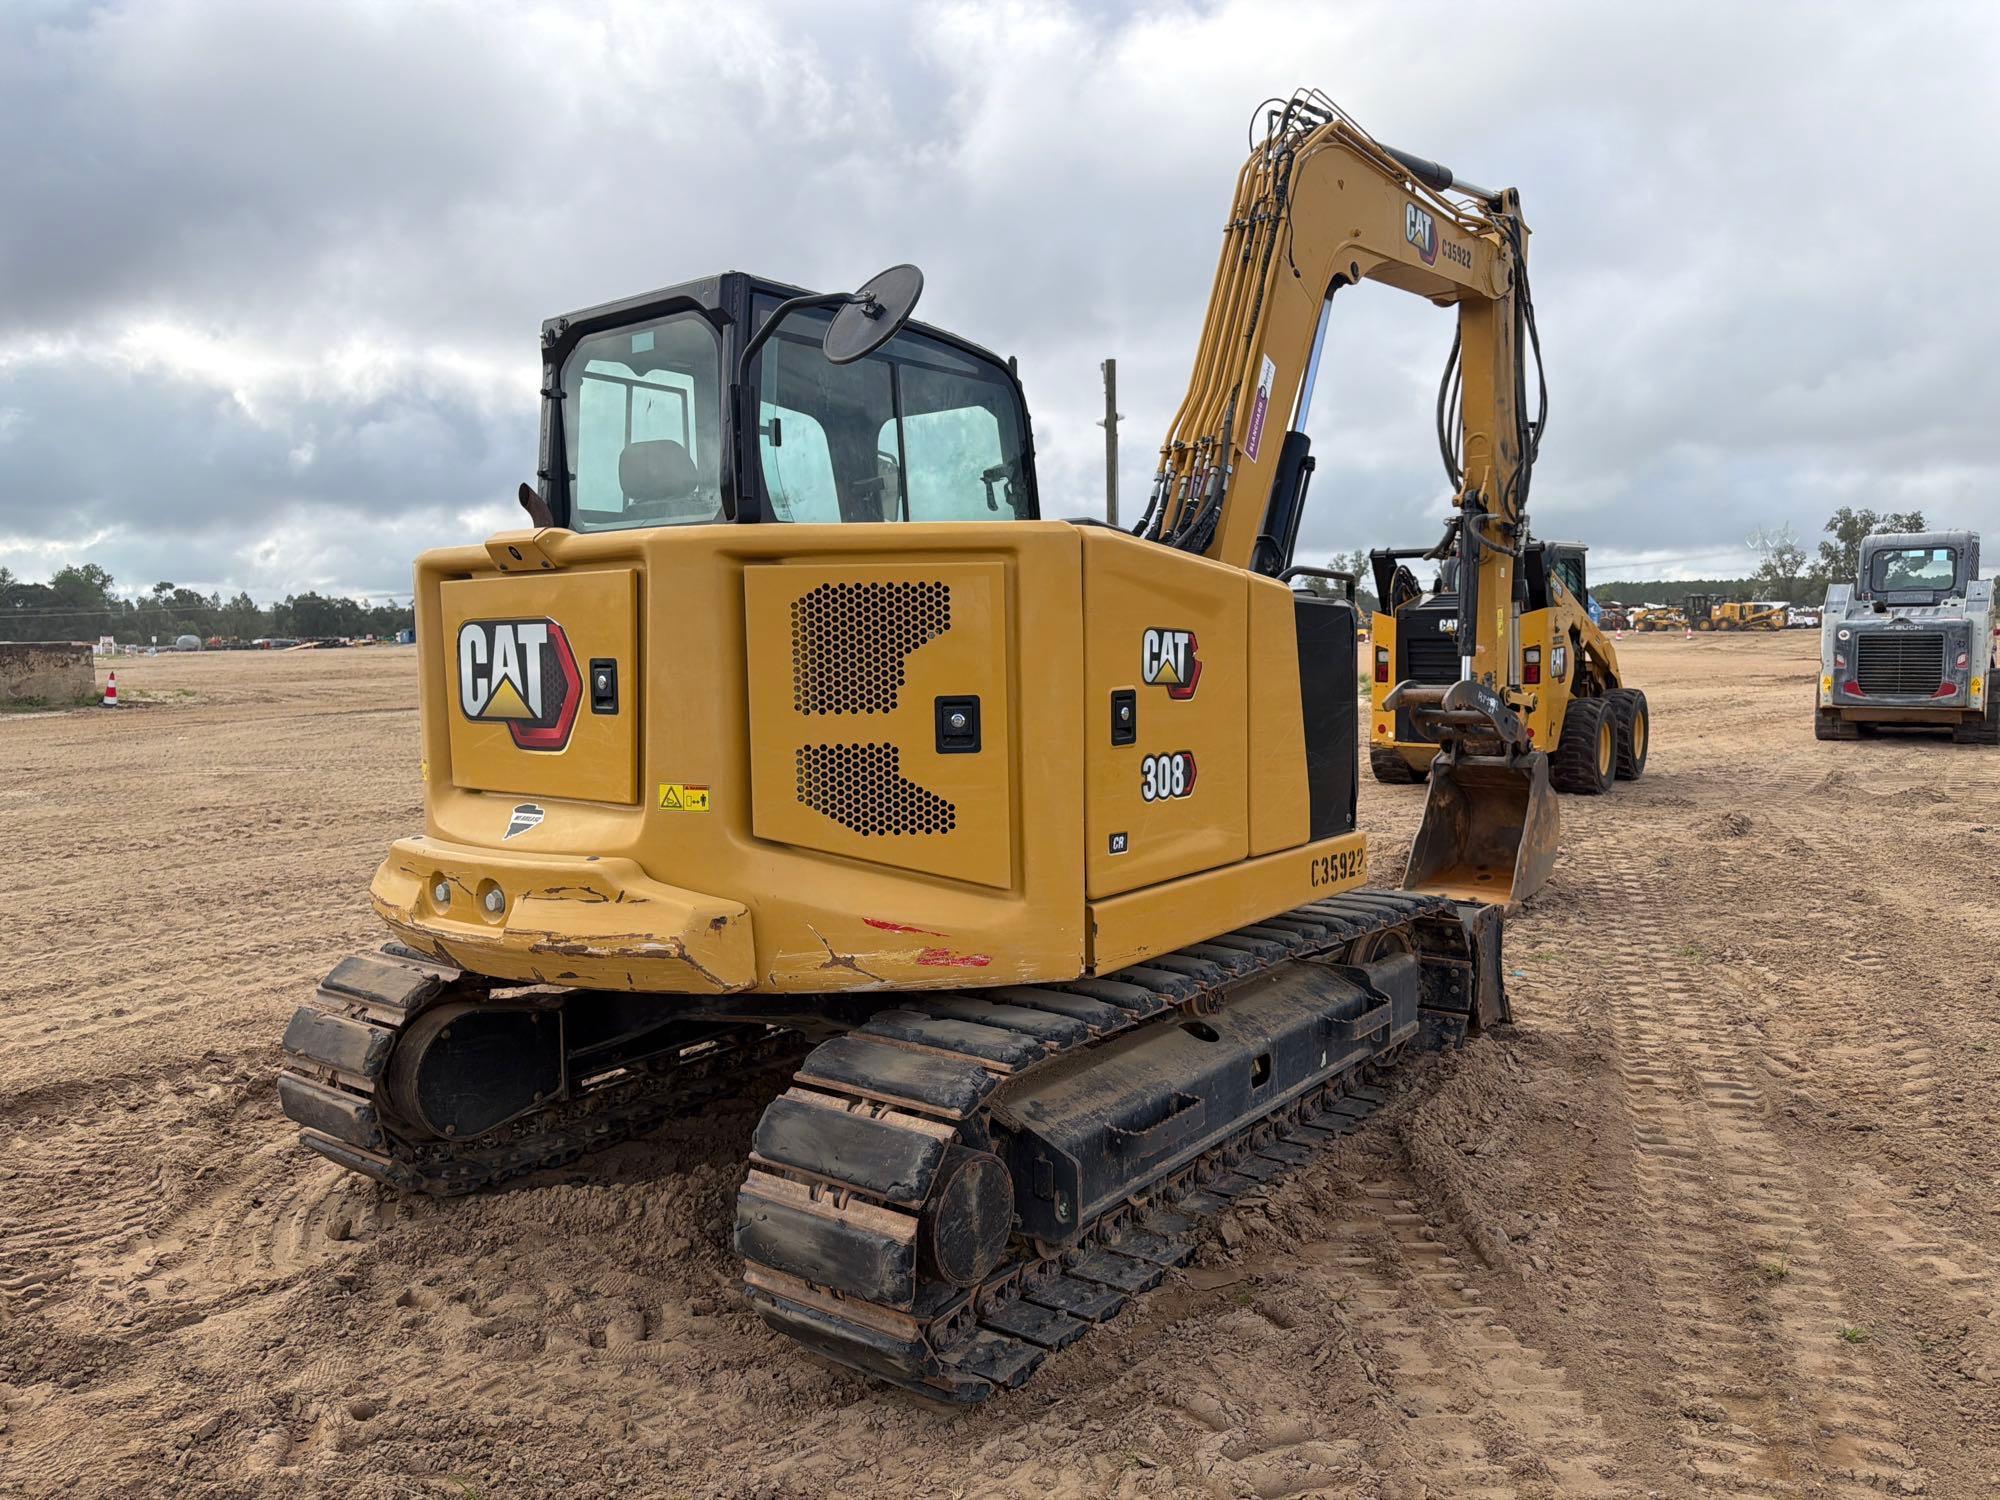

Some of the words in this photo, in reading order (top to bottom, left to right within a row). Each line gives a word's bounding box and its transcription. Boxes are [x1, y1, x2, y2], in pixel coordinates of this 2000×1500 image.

[1406, 203, 1432, 252] CAT
[1442, 238, 1472, 270] C35922
[1249, 401, 1265, 453] BLANCHARD
[460, 623, 548, 719] CAT
[1143, 629, 1189, 684] CAT
[1551, 647, 1565, 677] CAT
[1142, 754, 1184, 800] 308
[1112, 836, 1125, 850] CR
[1311, 847, 1364, 888] C35922
